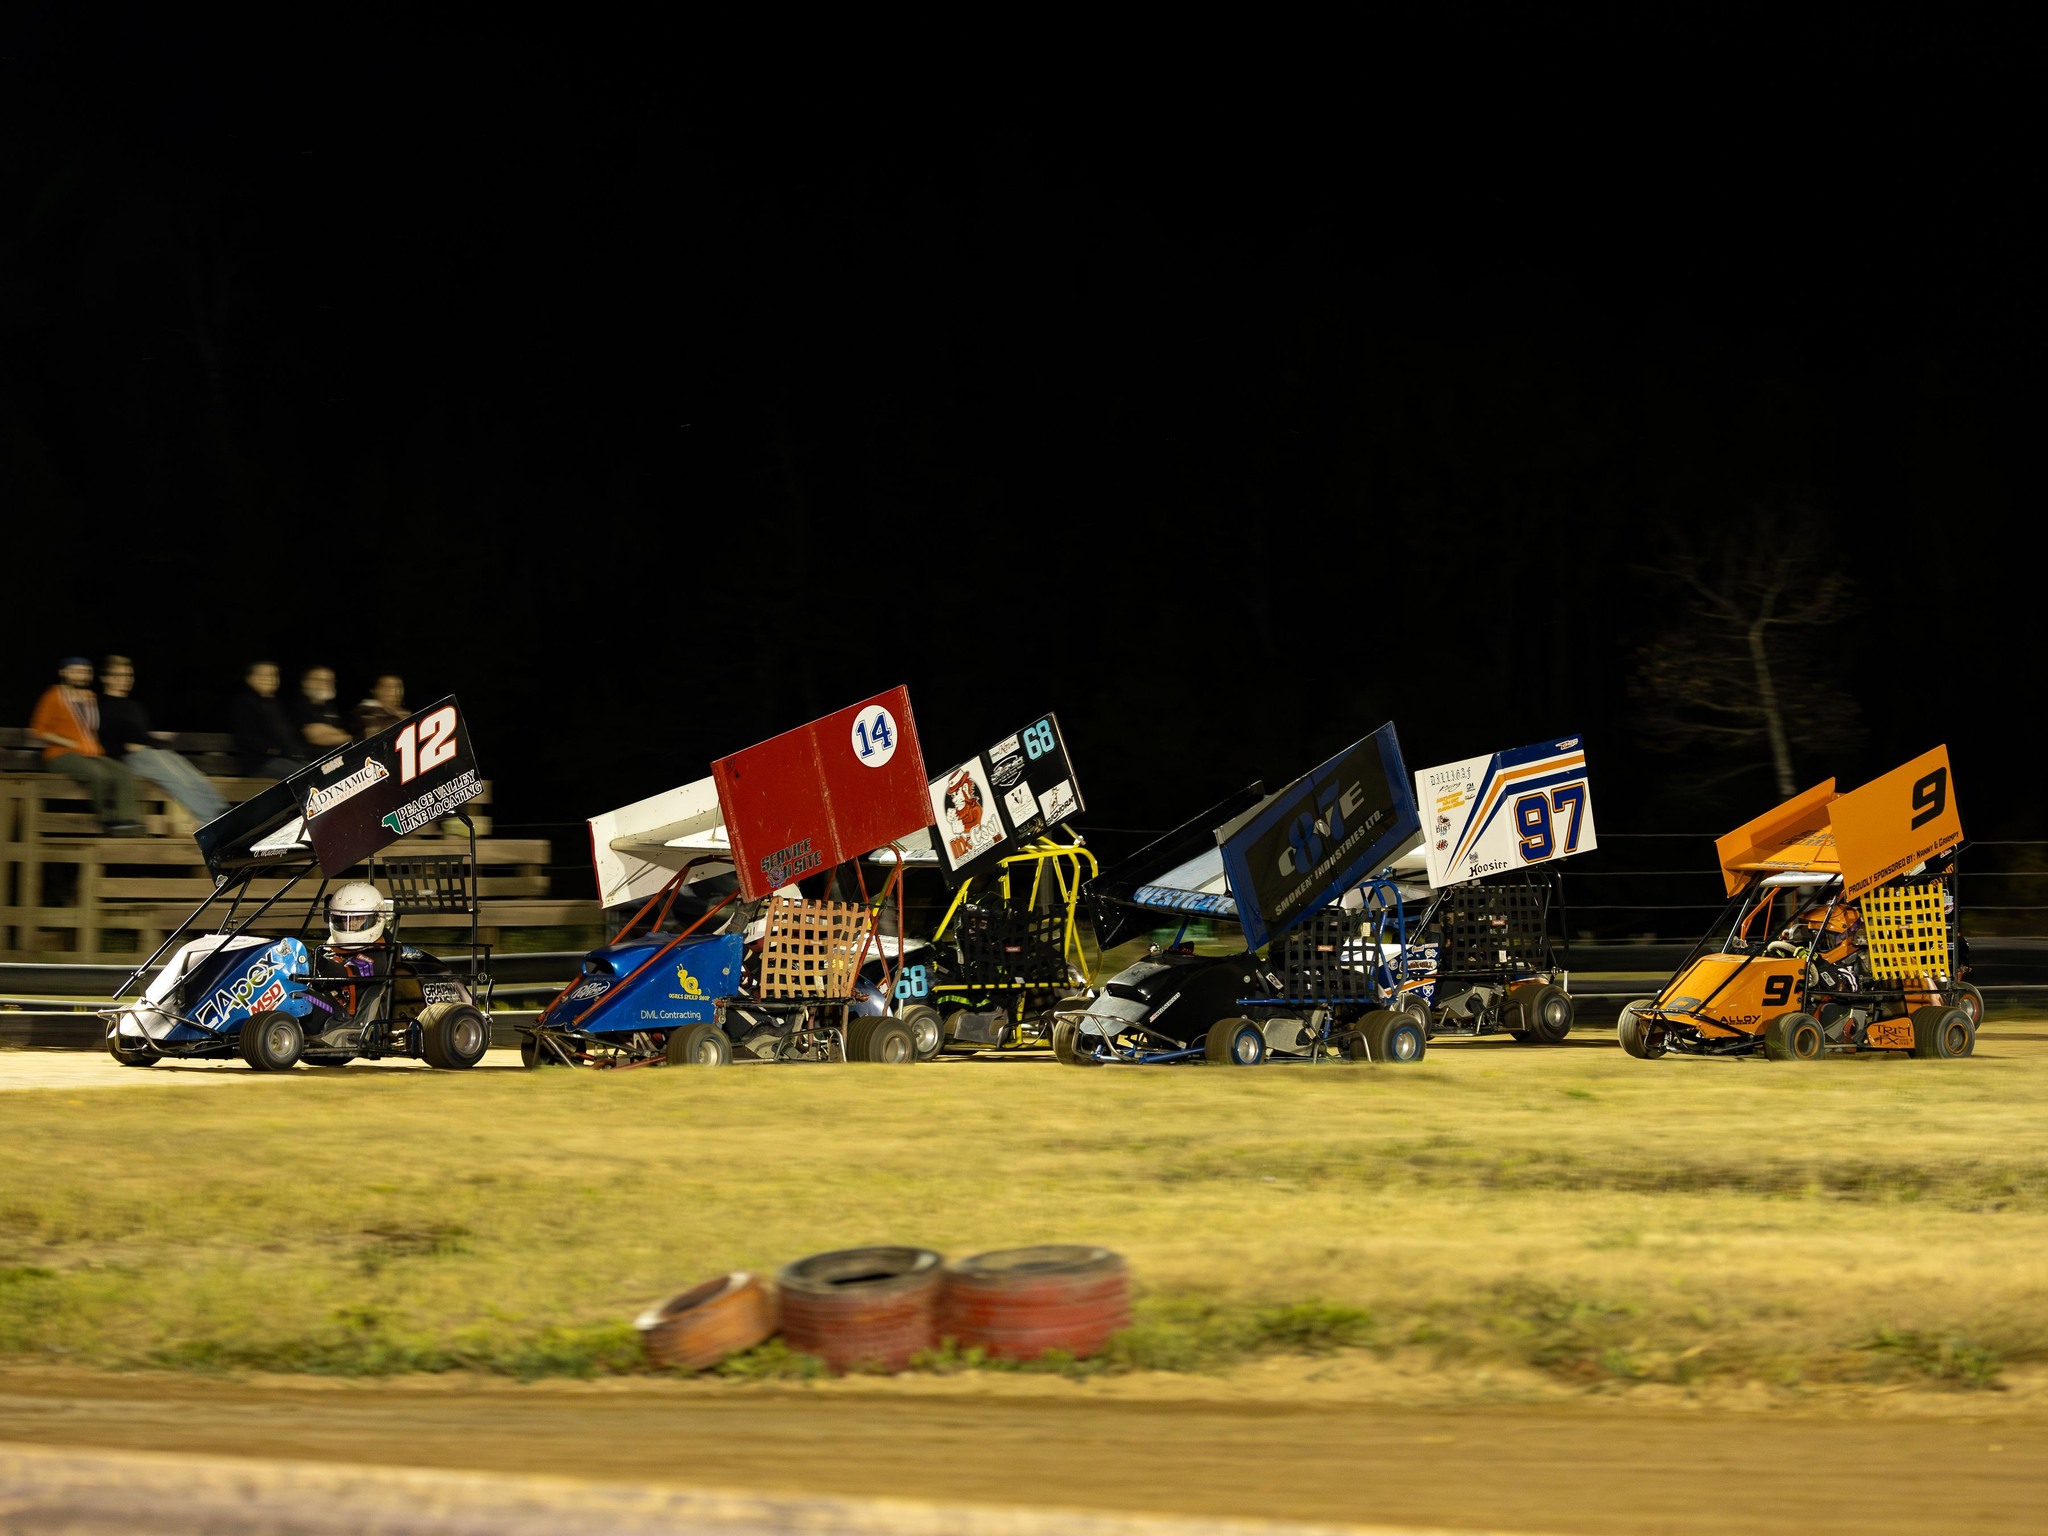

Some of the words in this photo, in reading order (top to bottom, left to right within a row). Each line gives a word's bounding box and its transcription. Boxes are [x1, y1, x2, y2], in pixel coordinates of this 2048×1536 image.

[395, 705, 457, 785] 12
[856, 712, 893, 759] 14
[1023, 719, 1055, 760] 68
[317, 767, 373, 805] DYNAMIC
[399, 791, 435, 820] PEACE
[433, 769, 476, 800] VALLEY
[1911, 766, 1947, 831] 9
[400, 807, 428, 834] LINE
[428, 781, 482, 818] LOCATING
[1289, 778, 1345, 874] 87
[1514, 781, 1586, 864] 97
[761, 838, 811, 873] SERVICE
[794, 850, 822, 875] SITE
[1314, 825, 1365, 878] INDUSTRIES
[1365, 809, 1384, 831] LTD.
[1468, 859, 1508, 877] Hoosier
[1848, 874, 1873, 895] PROUDLY
[1873, 858, 1905, 882] SPONSORED
[1906, 853, 1915, 865] BY:
[1933, 841, 1938, 849] &
[216, 948, 286, 1021] Apex
[250, 983, 283, 1014] MSD
[894, 964, 929, 999] 68
[1761, 974, 1795, 1007] 9
[641, 1010, 658, 1019] DML
[660, 1010, 701, 1020] Contracting
[1720, 1015, 1761, 1025] ALLOY
[1873, 1024, 1911, 1037] TRIM
